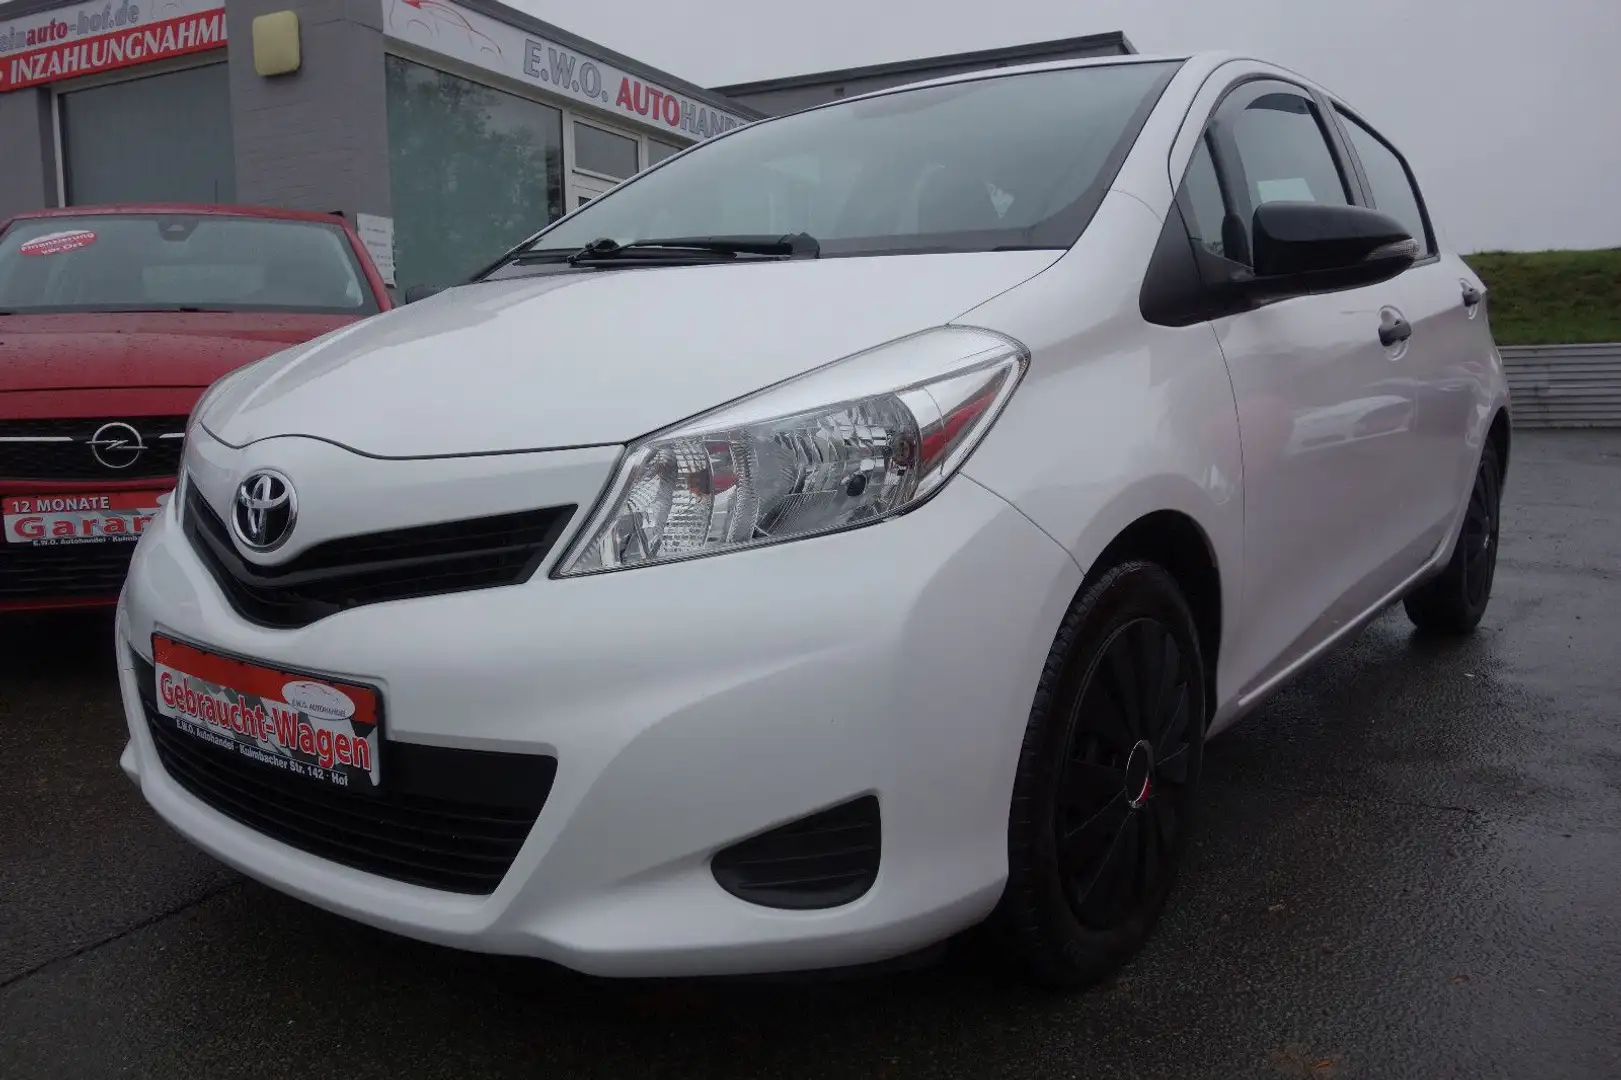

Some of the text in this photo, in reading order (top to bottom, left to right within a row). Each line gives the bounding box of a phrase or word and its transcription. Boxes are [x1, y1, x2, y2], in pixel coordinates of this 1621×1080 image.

[523, 38, 746, 139] E.W.O. AUTOHAN
[12, 496, 110, 513] 12 MONATE
[112, 535, 140, 543] Kulmb
[160, 671, 371, 771] Gebraucht-Wagen
[289, 759, 306, 775] Str.
[308, 765, 325, 780] 142
[332, 771, 348, 787] Hof
